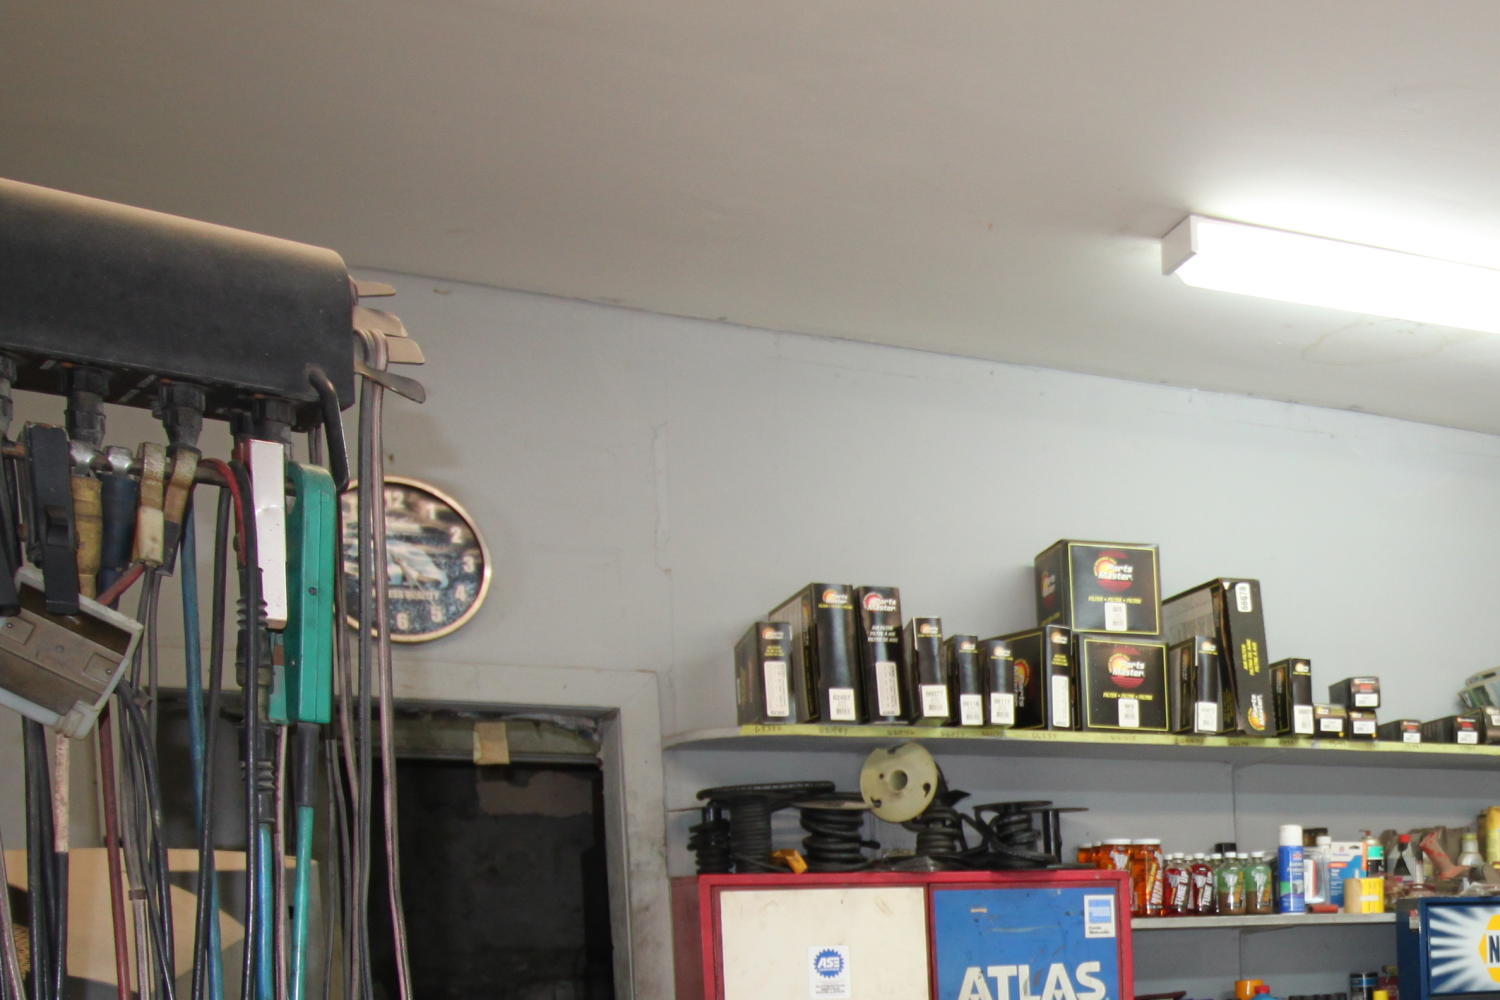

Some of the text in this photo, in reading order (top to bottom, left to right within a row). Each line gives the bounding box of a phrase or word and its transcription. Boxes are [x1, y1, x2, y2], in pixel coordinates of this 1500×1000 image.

[451, 527, 462, 544] 2
[462, 556, 474, 573] 3
[455, 584, 466, 602] 4
[396, 613, 409, 630] 6
[430, 608, 442, 624] 5
